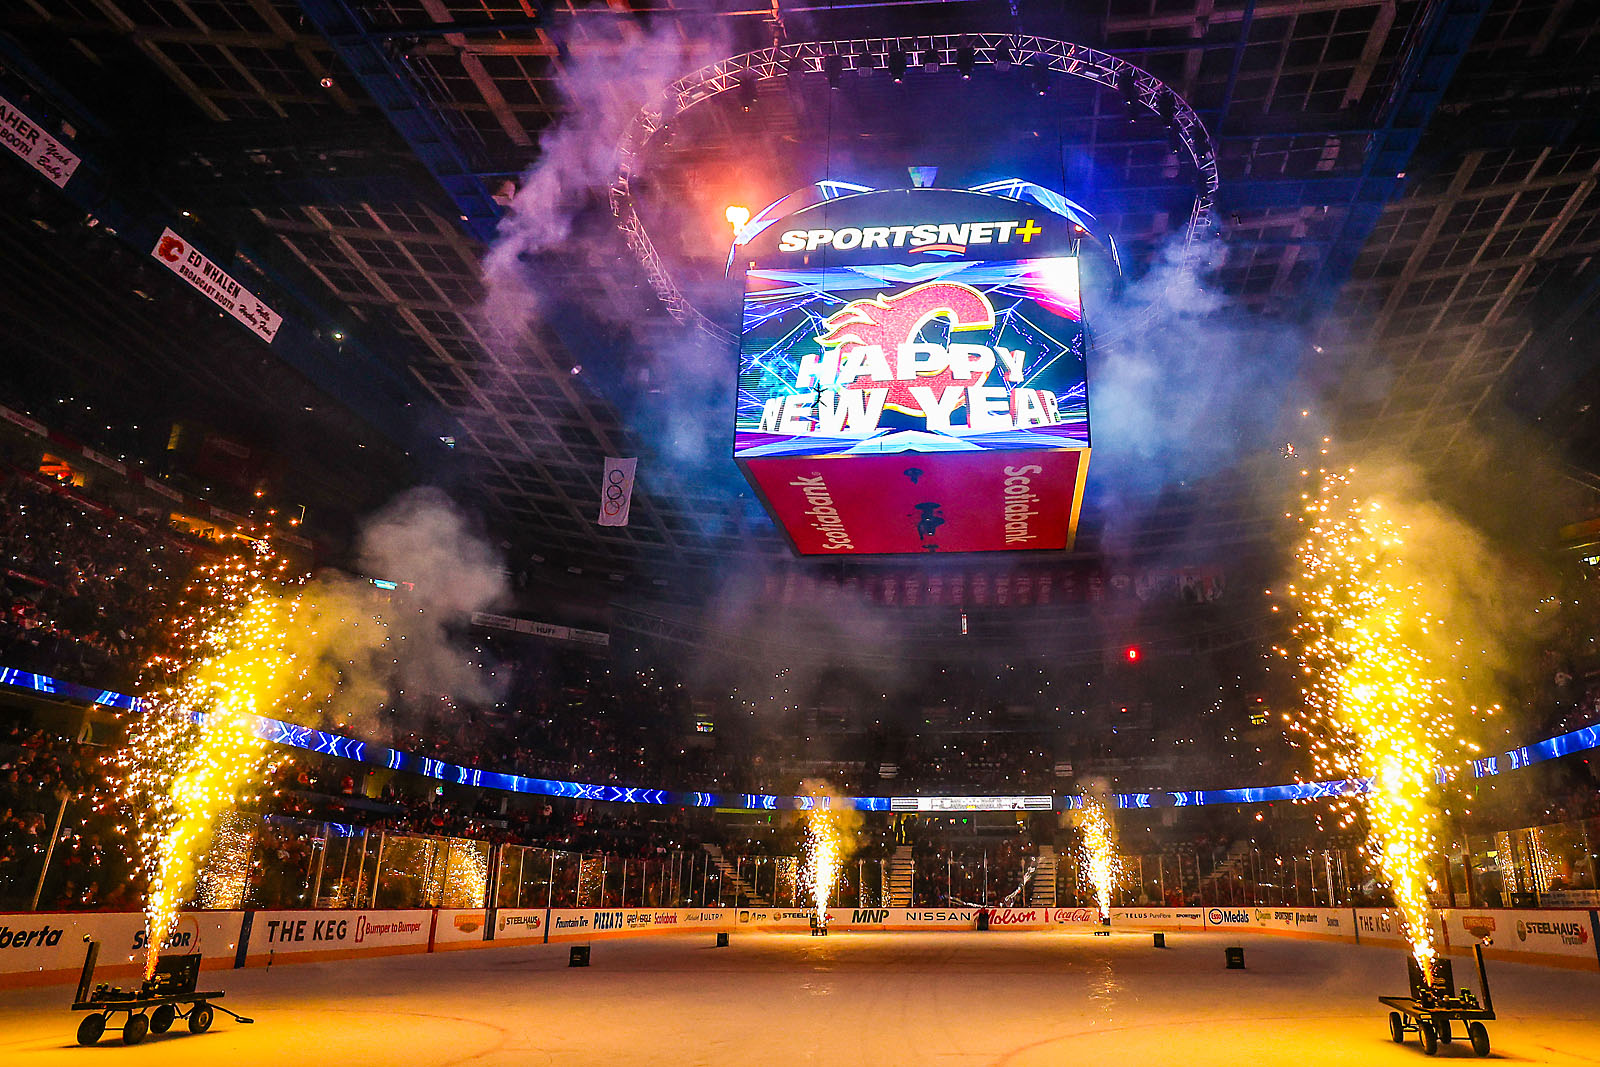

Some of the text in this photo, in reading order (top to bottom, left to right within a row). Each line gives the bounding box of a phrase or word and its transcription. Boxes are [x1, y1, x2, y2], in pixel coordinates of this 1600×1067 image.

[0, 128, 32, 155] BOOTH
[187, 250, 241, 299] ED WHALEN
[179, 265, 235, 310] BROADCAST BOOTH
[795, 343, 1026, 388] HAPPY
[758, 386, 1061, 432] NEW YEAR
[789, 472, 855, 550] Scotiabank
[1004, 464, 1043, 544] Scotiabank
[506, 916, 538, 925] STEELHAUS
[579, 915, 589, 927] Tire
[593, 911, 623, 930] PIZZA 73
[654, 912, 677, 924] Scotiabank
[852, 910, 889, 923] MNP
[906, 912, 971, 921] NISSAN
[1223, 910, 1249, 923] Medals
[1359, 915, 1374, 932] THE
[267, 920, 347, 942] THE KEG
[365, 920, 421, 936] Bumper to Bumper
[1525, 922, 1580, 936] STEELHAUS
